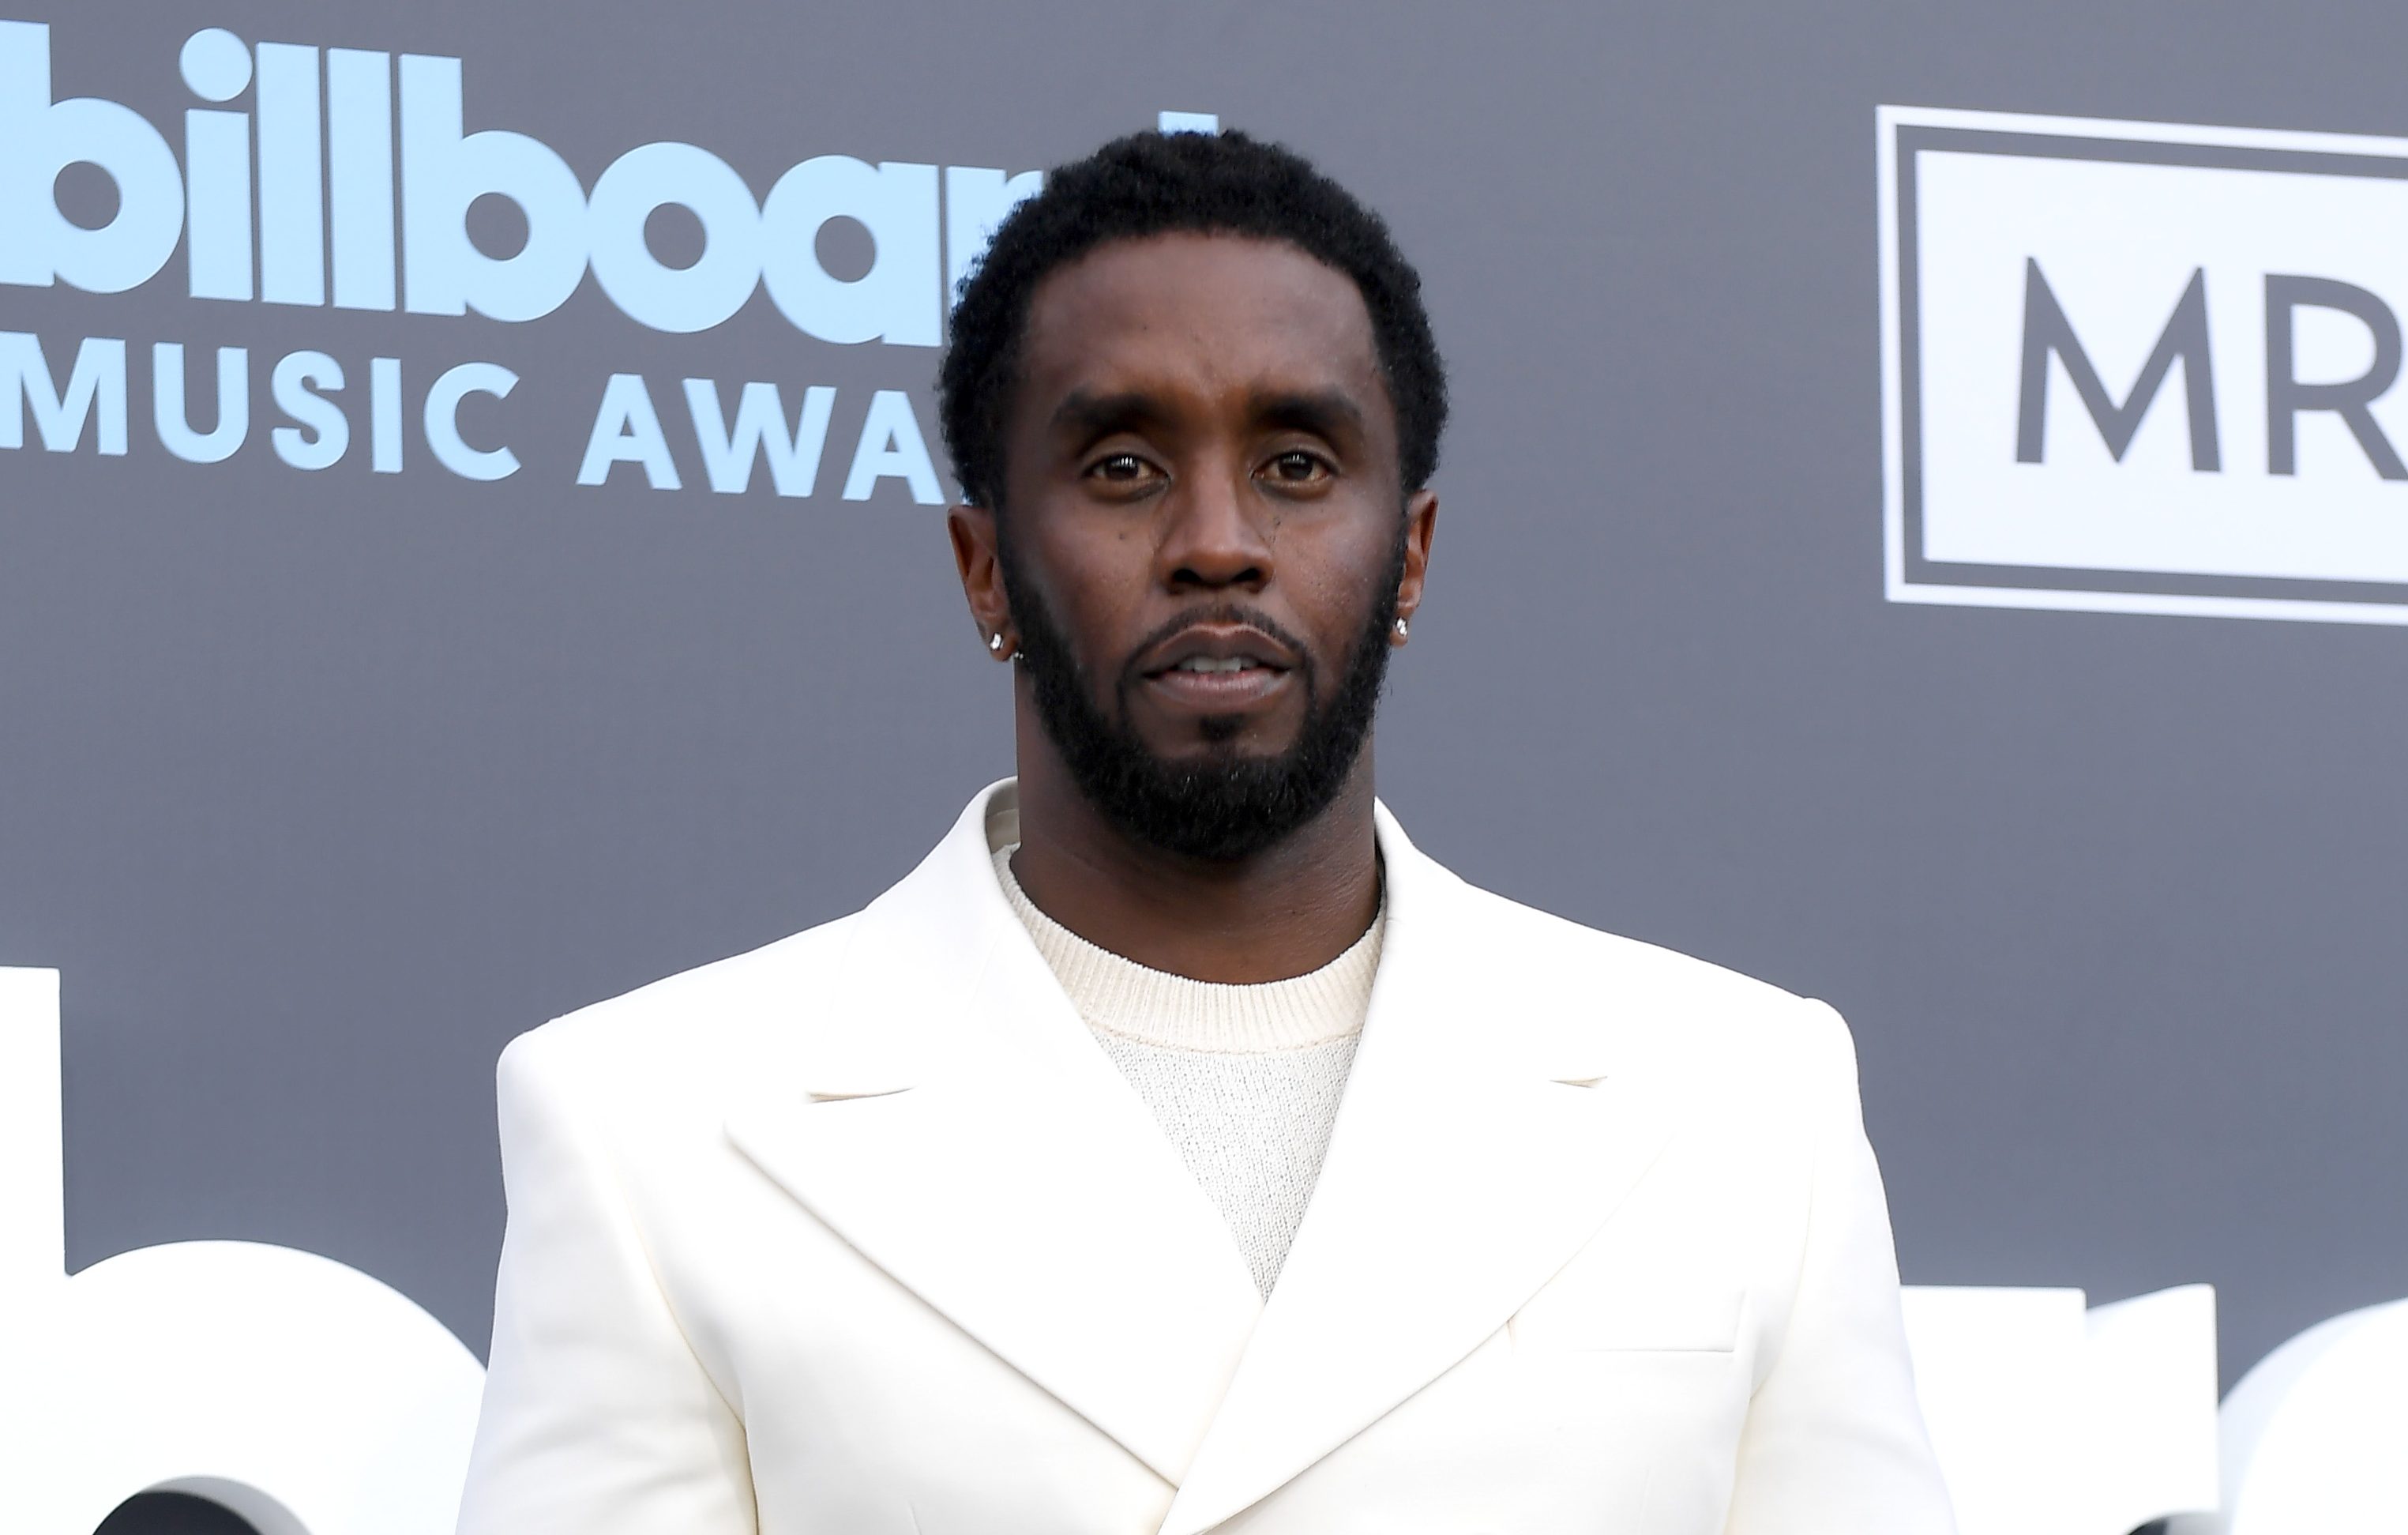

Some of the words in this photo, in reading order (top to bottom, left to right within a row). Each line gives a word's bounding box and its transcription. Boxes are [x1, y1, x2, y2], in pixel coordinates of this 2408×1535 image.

[0, 20, 1219, 346] billboar
[0, 331, 522, 481] MUSIC
[577, 373, 972, 506] AWA
[2015, 256, 2408, 482] MR
